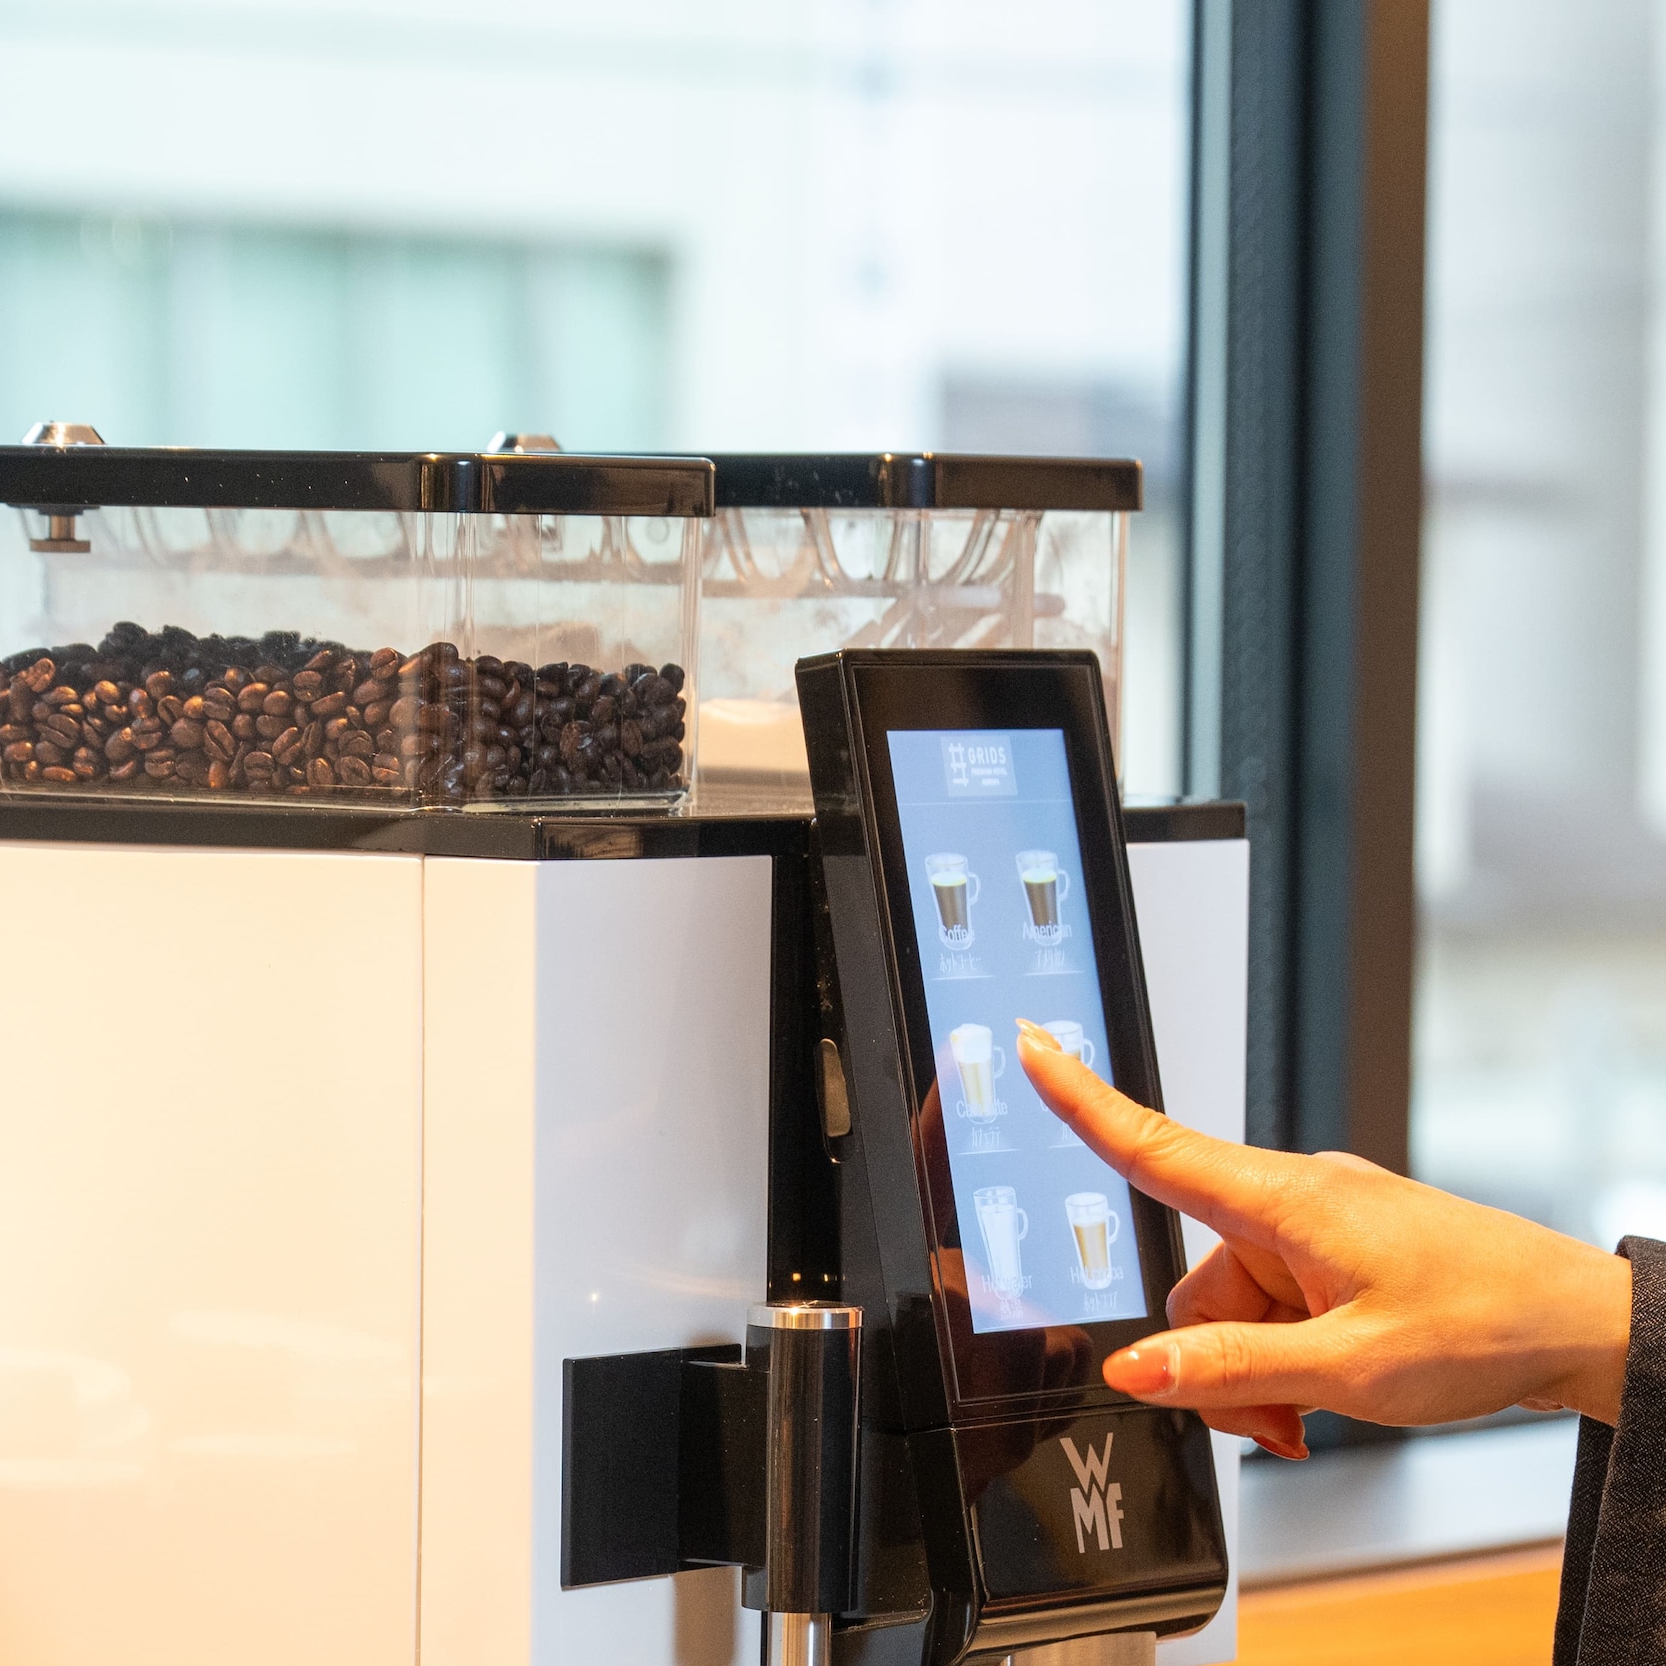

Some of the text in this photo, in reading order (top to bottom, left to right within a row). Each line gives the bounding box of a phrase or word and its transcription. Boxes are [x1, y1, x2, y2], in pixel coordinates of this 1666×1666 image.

[968, 746, 1007, 765] GRIDS
[939, 923, 975, 942] Coffee
[1022, 920, 1072, 940] American
[1059, 1432, 1125, 1554] WMF
